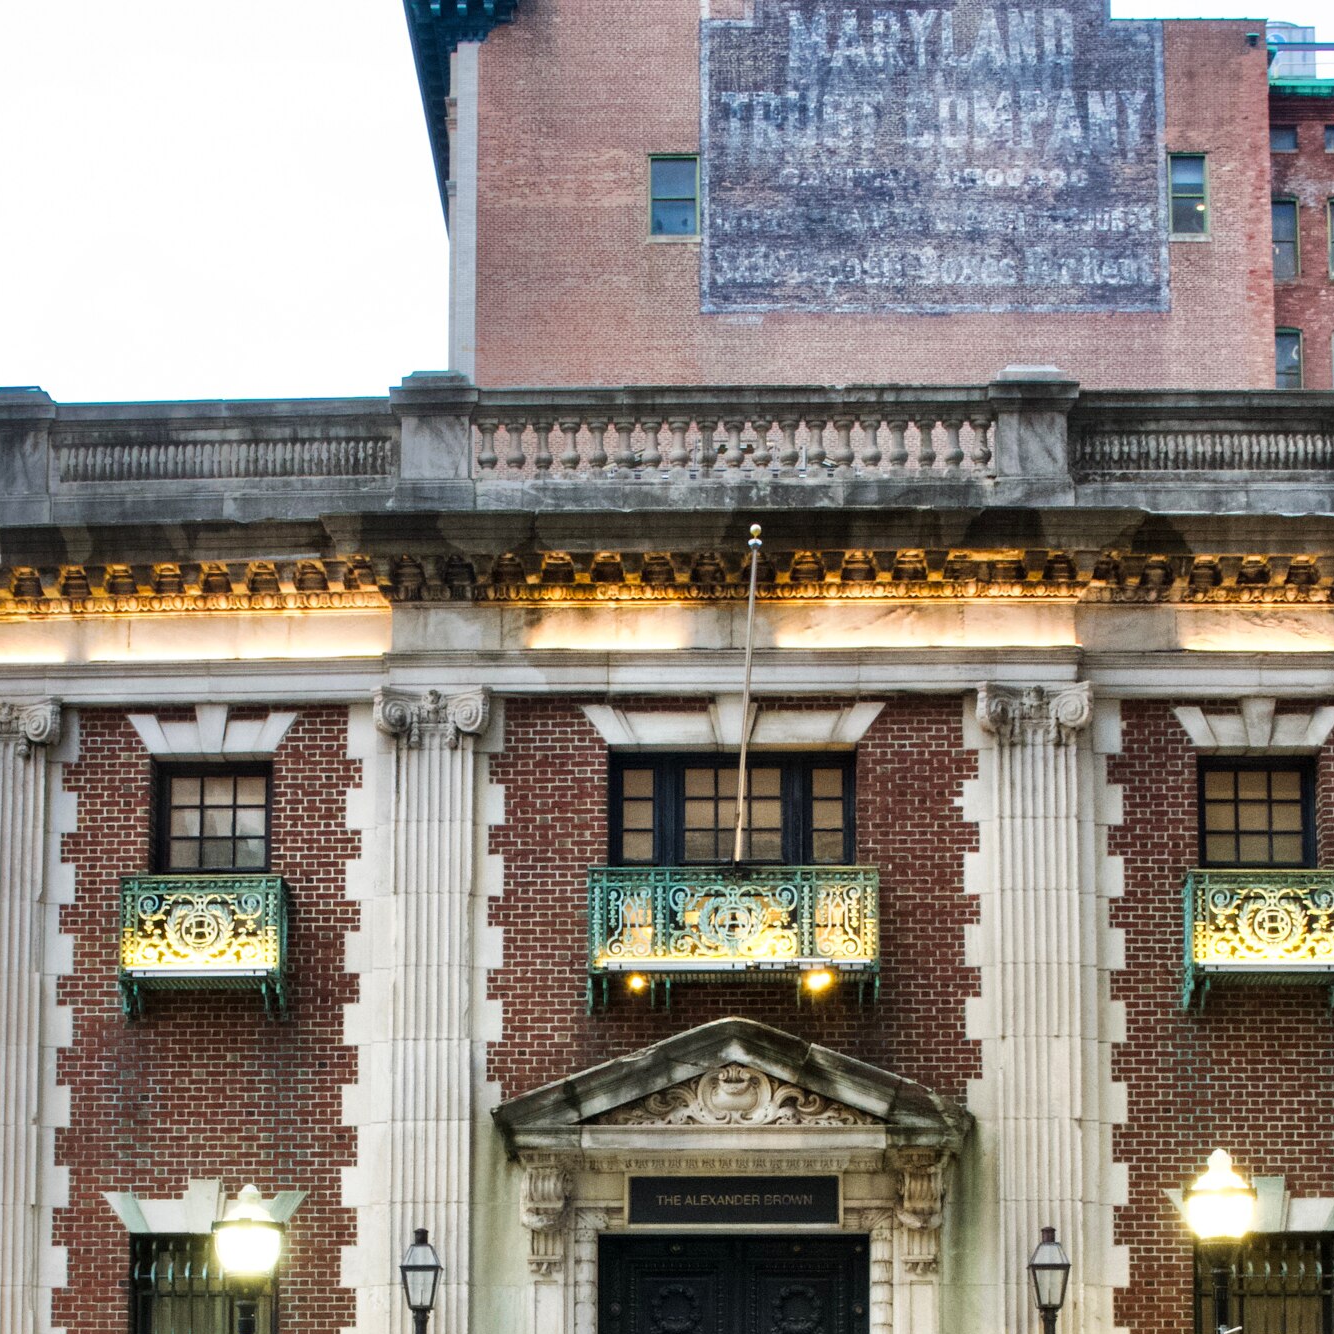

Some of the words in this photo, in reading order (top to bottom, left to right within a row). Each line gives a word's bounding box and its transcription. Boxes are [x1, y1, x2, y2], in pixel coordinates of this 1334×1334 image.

[787, 9, 1074, 68] MARYLAND
[905, 90, 1149, 150] COMPANY
[657, 1195, 681, 1206] THE
[684, 1195, 760, 1206] ALEXANDER
[764, 1195, 813, 1206] BROWN
